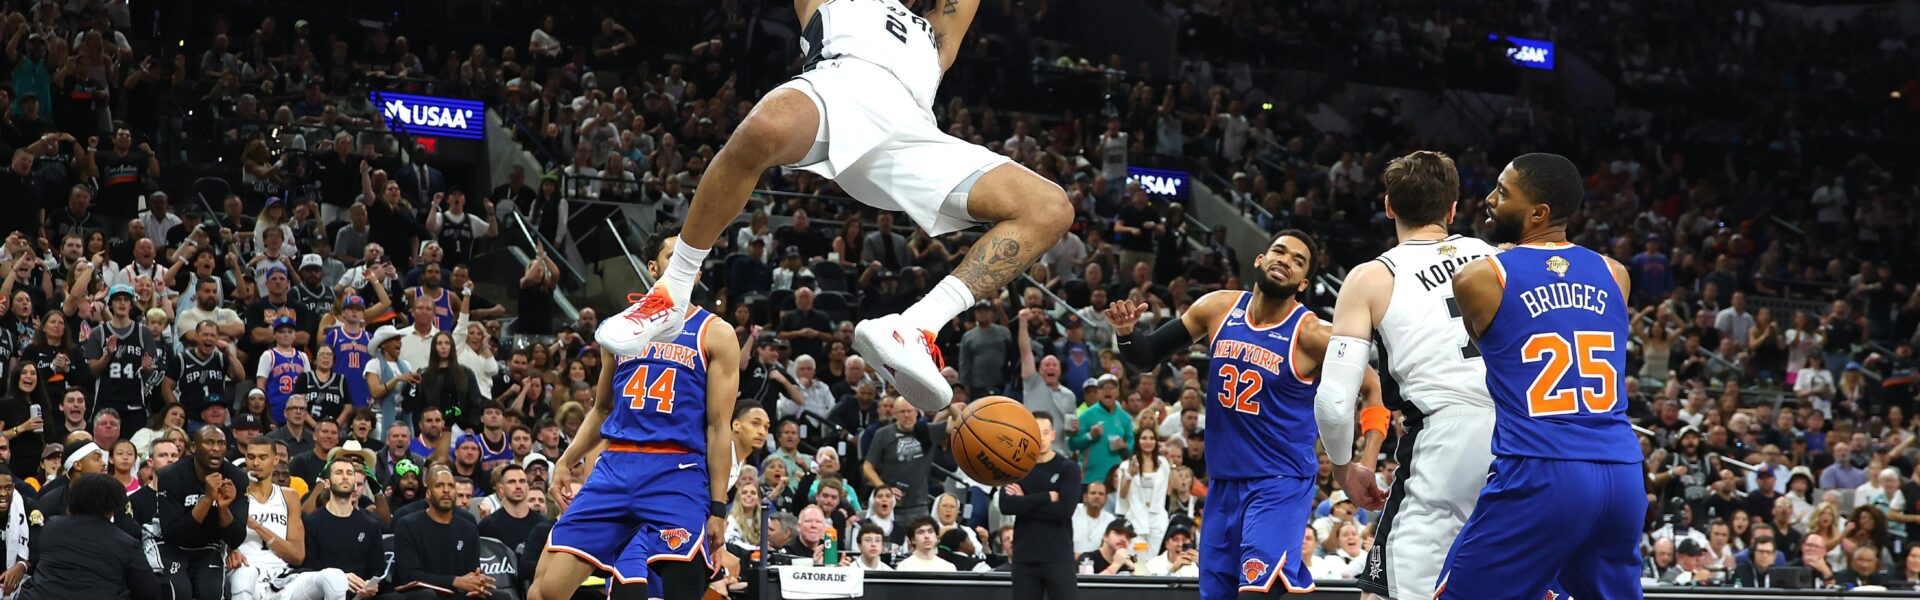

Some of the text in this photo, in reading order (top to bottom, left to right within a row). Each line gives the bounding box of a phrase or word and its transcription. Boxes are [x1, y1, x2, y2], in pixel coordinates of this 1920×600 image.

[885, 14, 908, 44] 2
[413, 104, 467, 129] USAA
[1520, 282, 1608, 318] BRIDGES
[349, 352, 360, 368] 11
[653, 341, 698, 370] YORK
[1213, 340, 1284, 376] NEW YORK
[110, 362, 134, 379] 24
[186, 369, 222, 384] SPURS
[1521, 331, 1617, 417] 25
[203, 386, 209, 397] 1
[622, 365, 676, 414] 44
[1218, 364, 1263, 415] 32
[311, 405, 322, 419] 5
[479, 555, 516, 575] nals
[792, 571, 847, 582] GATORADE
